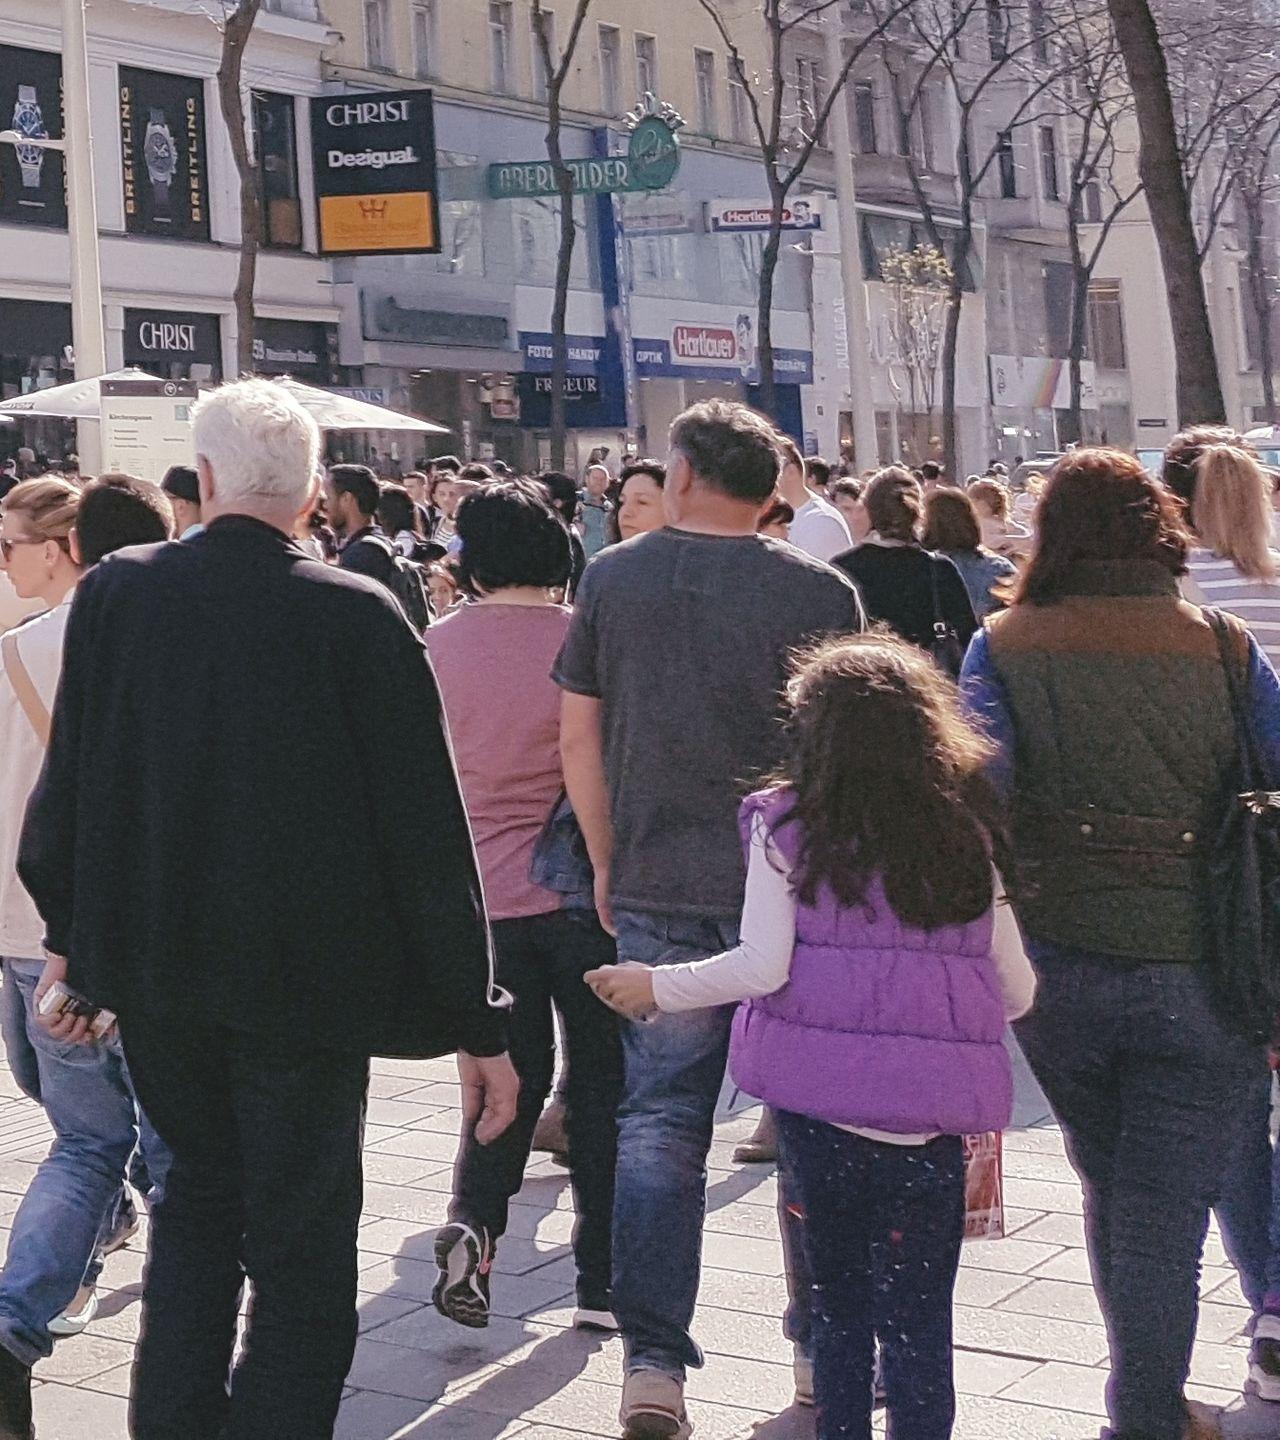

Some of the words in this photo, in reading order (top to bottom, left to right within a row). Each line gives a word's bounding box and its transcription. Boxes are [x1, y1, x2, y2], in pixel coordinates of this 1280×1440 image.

[326, 100, 410, 126] CHRIST
[121, 87, 135, 213] BREITLING
[186, 97, 201, 222] BREITLING
[139, 321, 196, 352] CHRIST
[678, 328, 733, 358] Hartlauer
[567, 348, 600, 361] HANDY
[636, 351, 663, 364] OPTIK
[535, 377, 597, 392] FREUR
